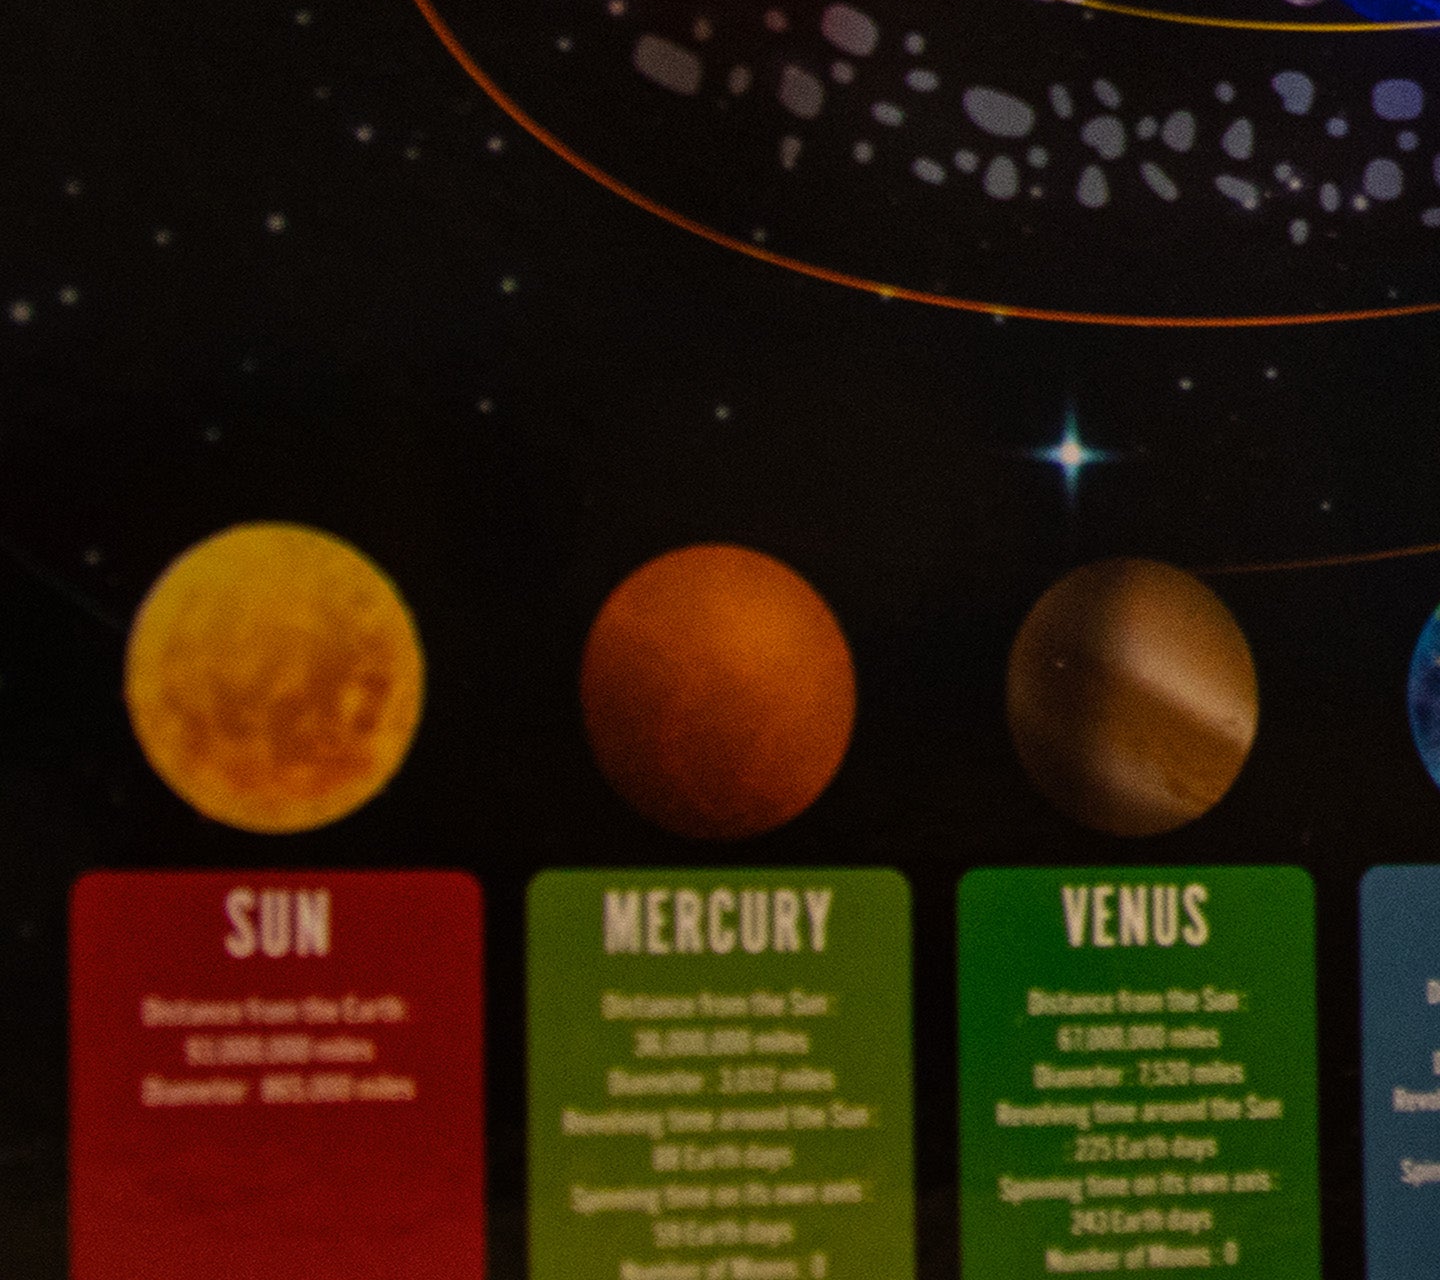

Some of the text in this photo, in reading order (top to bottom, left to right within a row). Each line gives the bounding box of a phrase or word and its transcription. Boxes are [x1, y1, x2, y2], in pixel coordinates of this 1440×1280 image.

[225, 887, 331, 958] SUN
[604, 887, 833, 954] MERCURY
[1061, 883, 1209, 947] VENUS
